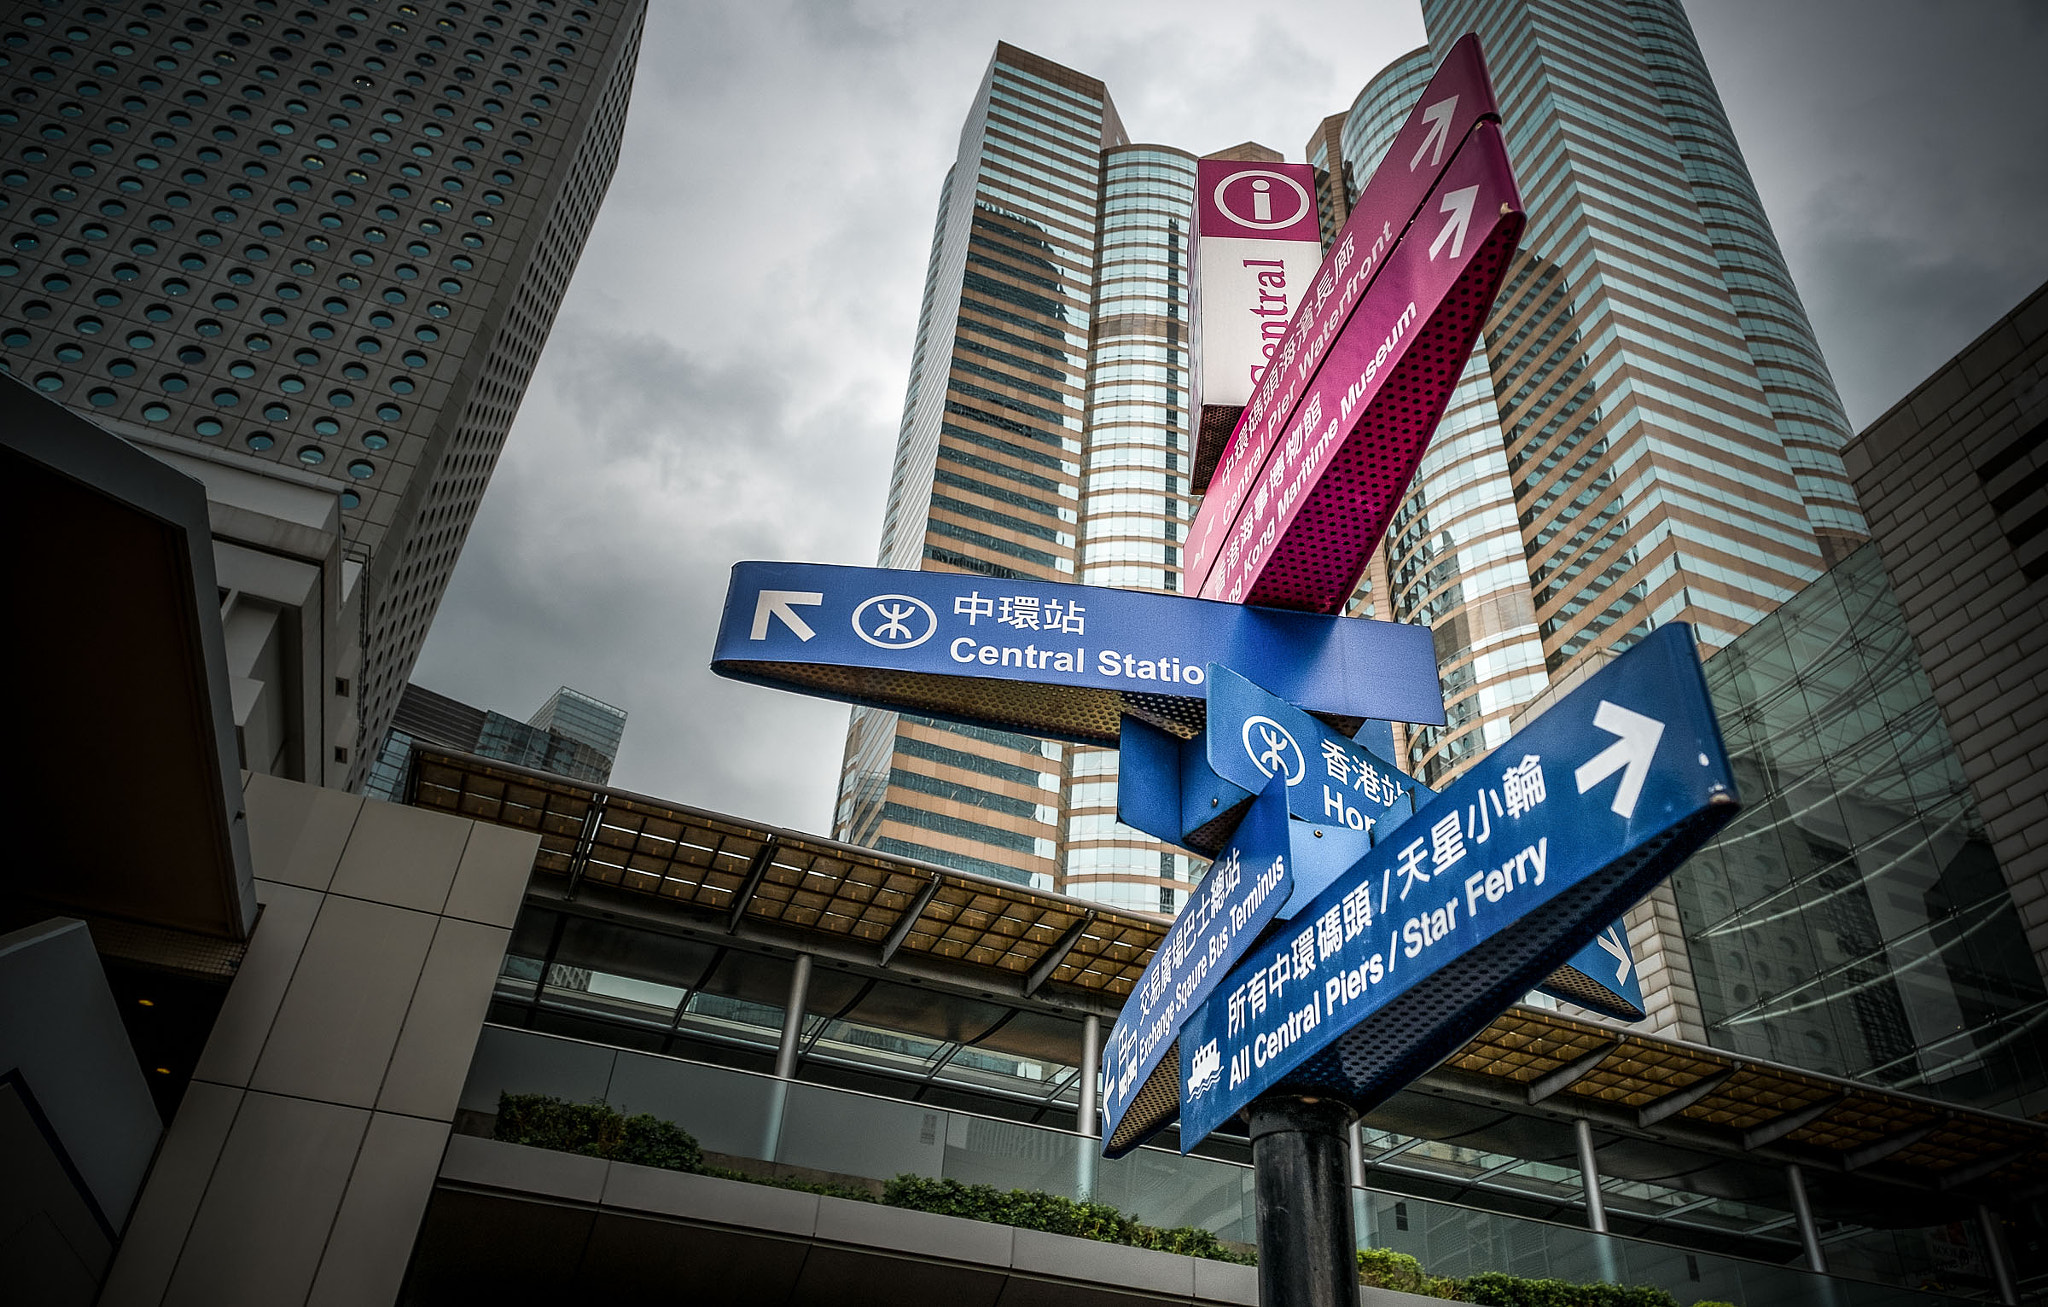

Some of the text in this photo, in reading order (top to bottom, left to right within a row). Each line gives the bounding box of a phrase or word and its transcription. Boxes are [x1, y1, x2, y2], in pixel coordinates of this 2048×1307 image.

[1222, 231, 1355, 488] 中環碼頭海濱長廊
[1222, 219, 1393, 525] Central Pier Waterfront
[1243, 516, 1275, 580] Kong
[1277, 417, 1339, 522] Maritime
[1340, 301, 1417, 422] Museum
[950, 637, 1205, 685] Central Statio
[953, 591, 1086, 635] 中環站
[1139, 847, 1240, 1026] 交易廣場巴士總站
[1139, 855, 1284, 1066] Exchange Sqaure Bus Terminus
[1227, 754, 1547, 1039] 所有中環碼頭 / 天星小輪
[1229, 836, 1548, 1091] All Central Piers / Star Ferry
